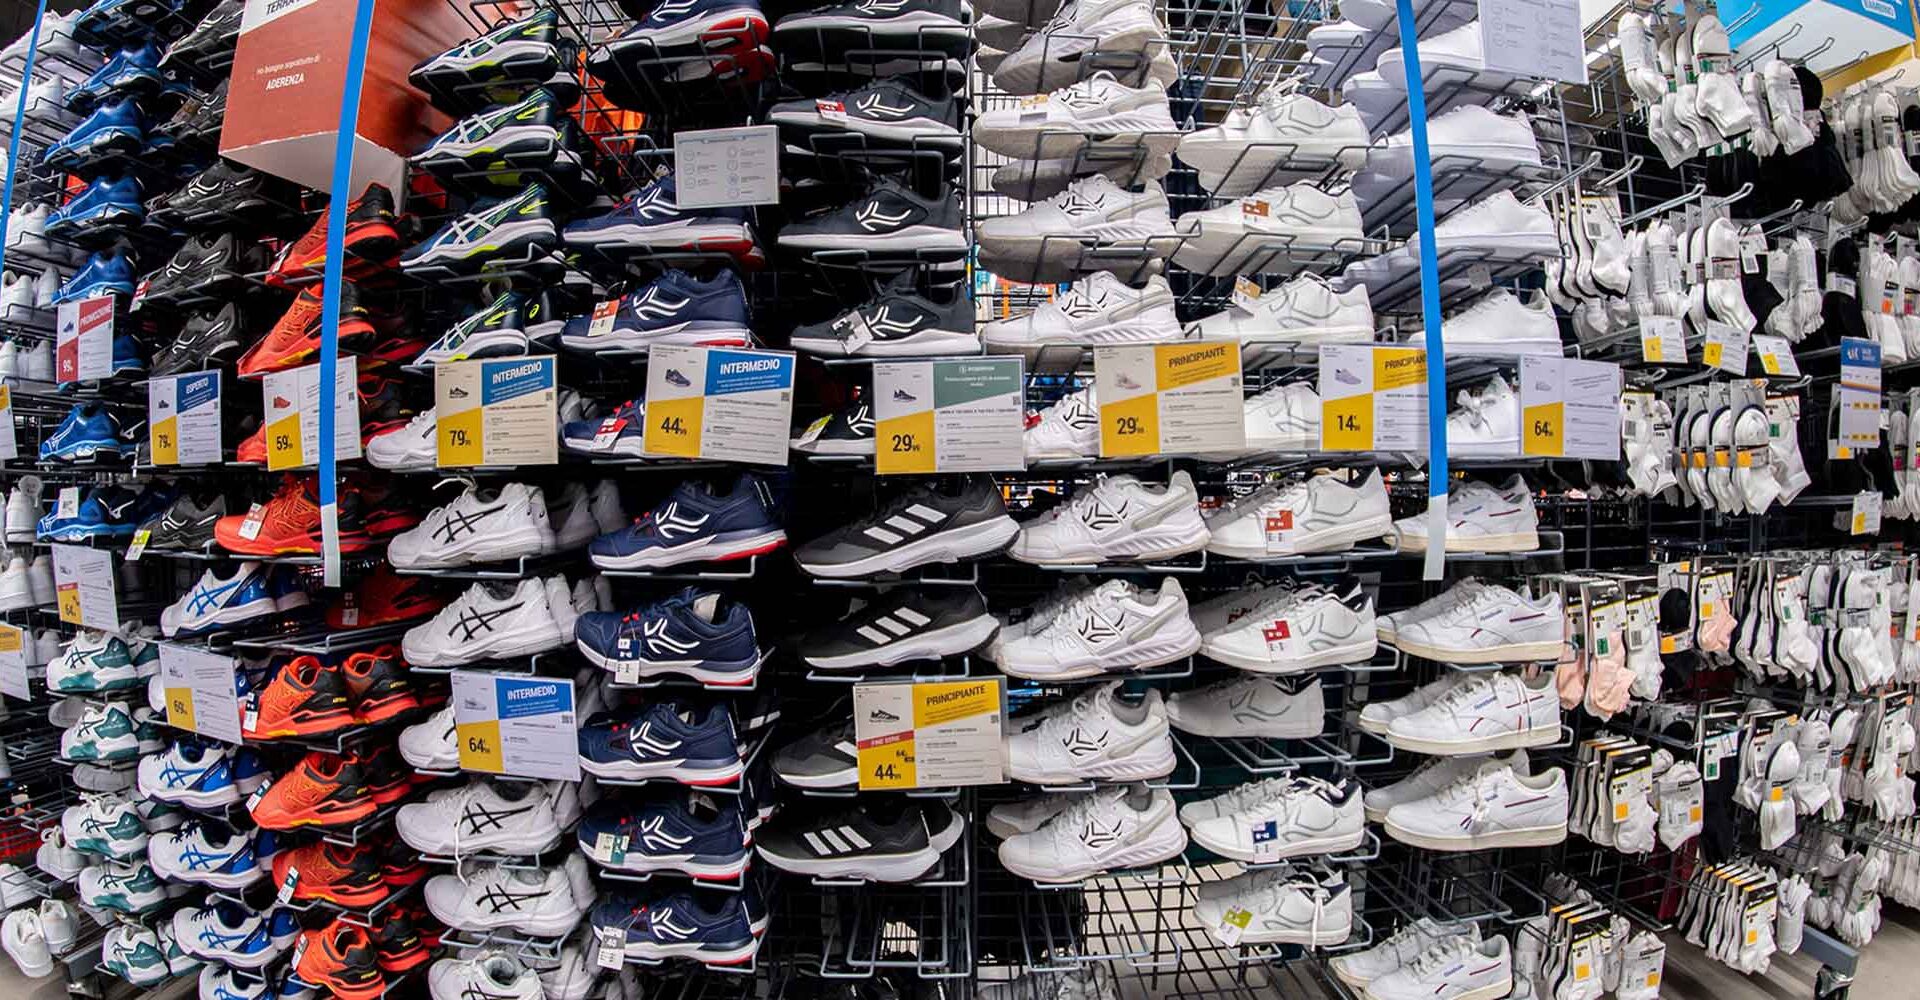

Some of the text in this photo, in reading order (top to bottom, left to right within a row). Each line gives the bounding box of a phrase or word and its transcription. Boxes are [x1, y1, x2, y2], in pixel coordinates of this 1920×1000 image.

[265, 73, 305, 91] ADERENZA
[719, 358, 780, 375] INTERMEDIO
[1168, 345, 1227, 368] PRINCIPIANTE
[492, 361, 542, 385] INTERMEDIO
[507, 684, 557, 701] INTERMEDIO
[926, 684, 986, 706] PRINCIPIANTE
